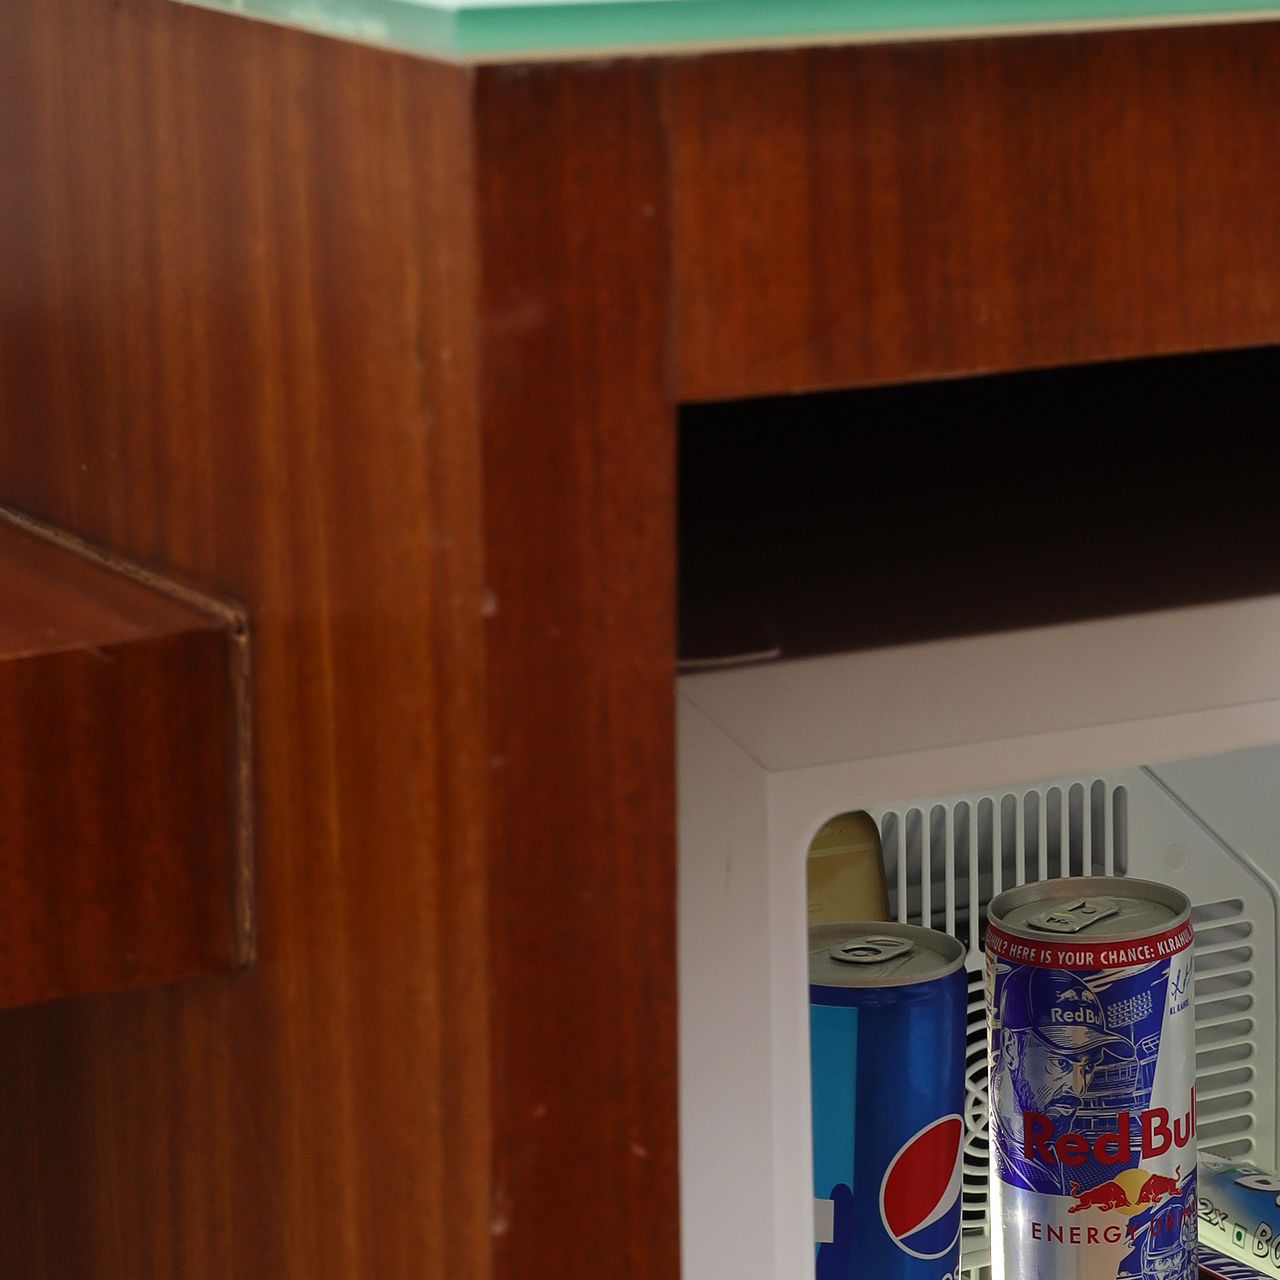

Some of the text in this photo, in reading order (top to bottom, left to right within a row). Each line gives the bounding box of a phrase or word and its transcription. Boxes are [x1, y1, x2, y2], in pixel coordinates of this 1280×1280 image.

[1010, 943, 1155, 966] HERE IS YOUR CHANCE:
[1051, 1007, 1082, 1022] Red
[1023, 1110, 1131, 1165] Red
[1198, 1197, 1229, 1232] 2x
[1032, 1221, 1136, 1245] ENERGY
